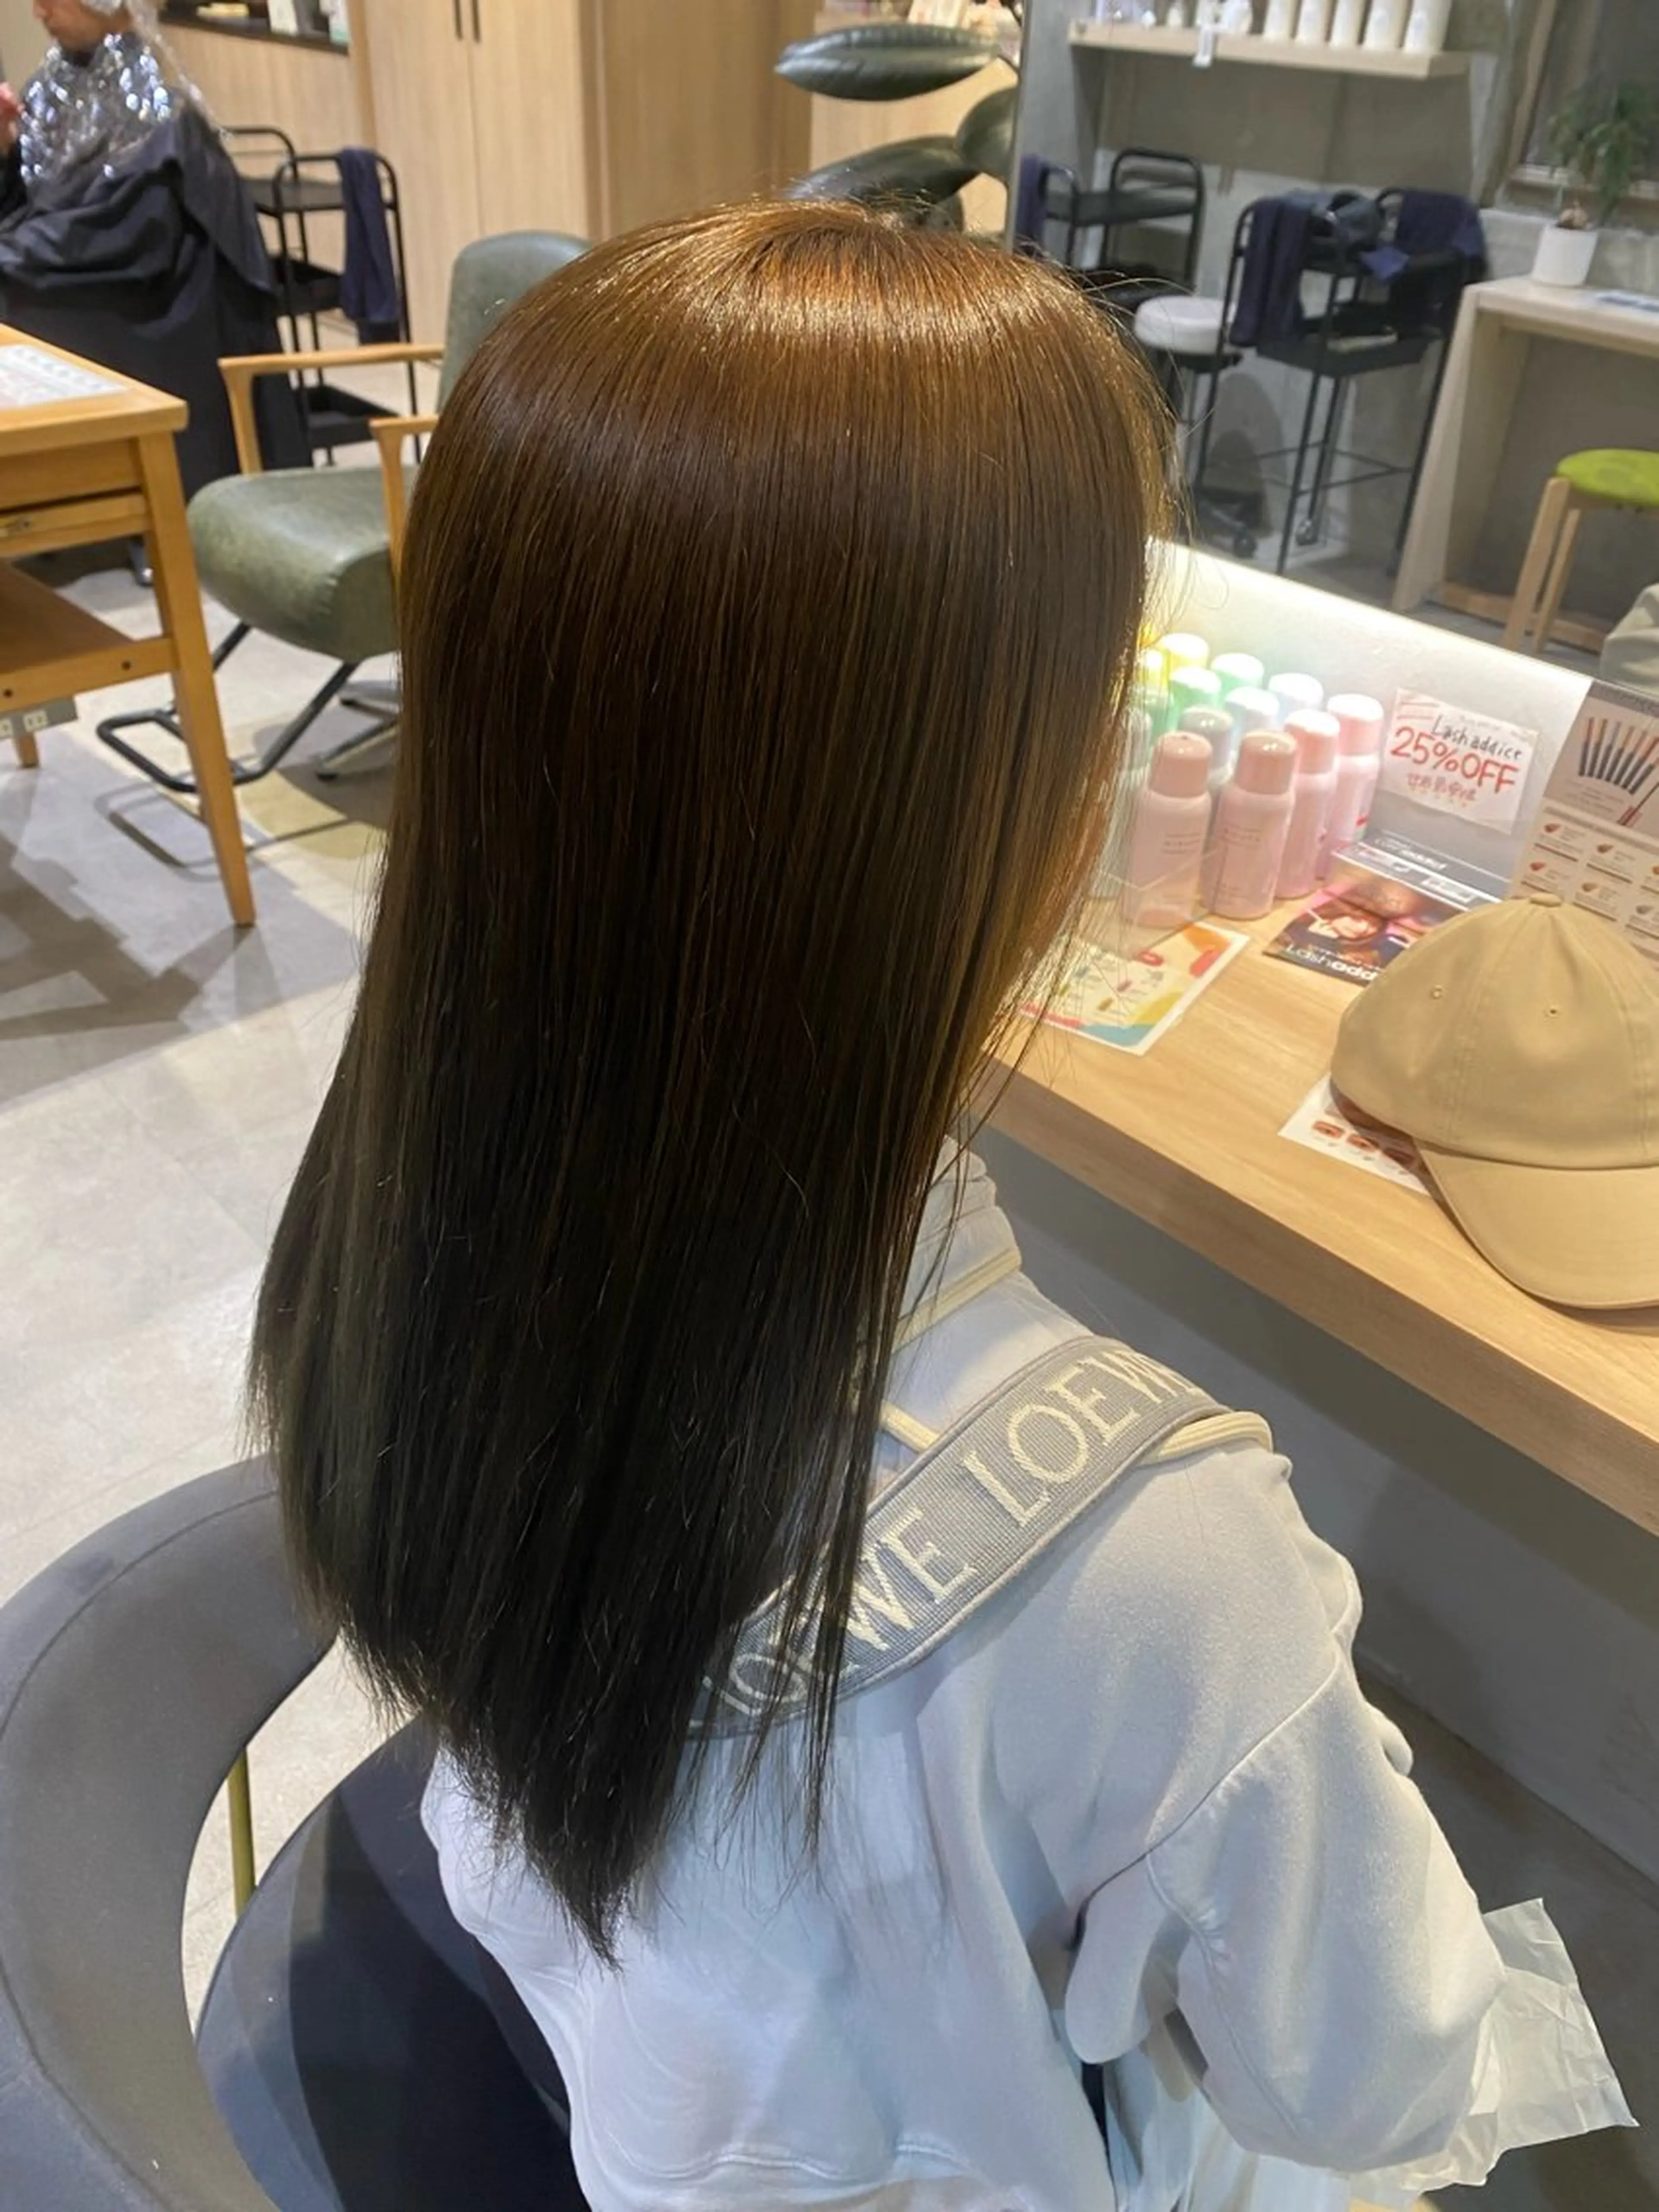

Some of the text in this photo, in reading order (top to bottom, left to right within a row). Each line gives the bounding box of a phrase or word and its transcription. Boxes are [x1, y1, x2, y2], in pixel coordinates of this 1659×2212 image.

[1431, 713, 1468, 746] Lash
[1391, 726, 1519, 794] 25%OFF
[1285, 943, 1379, 981] Lashadd
